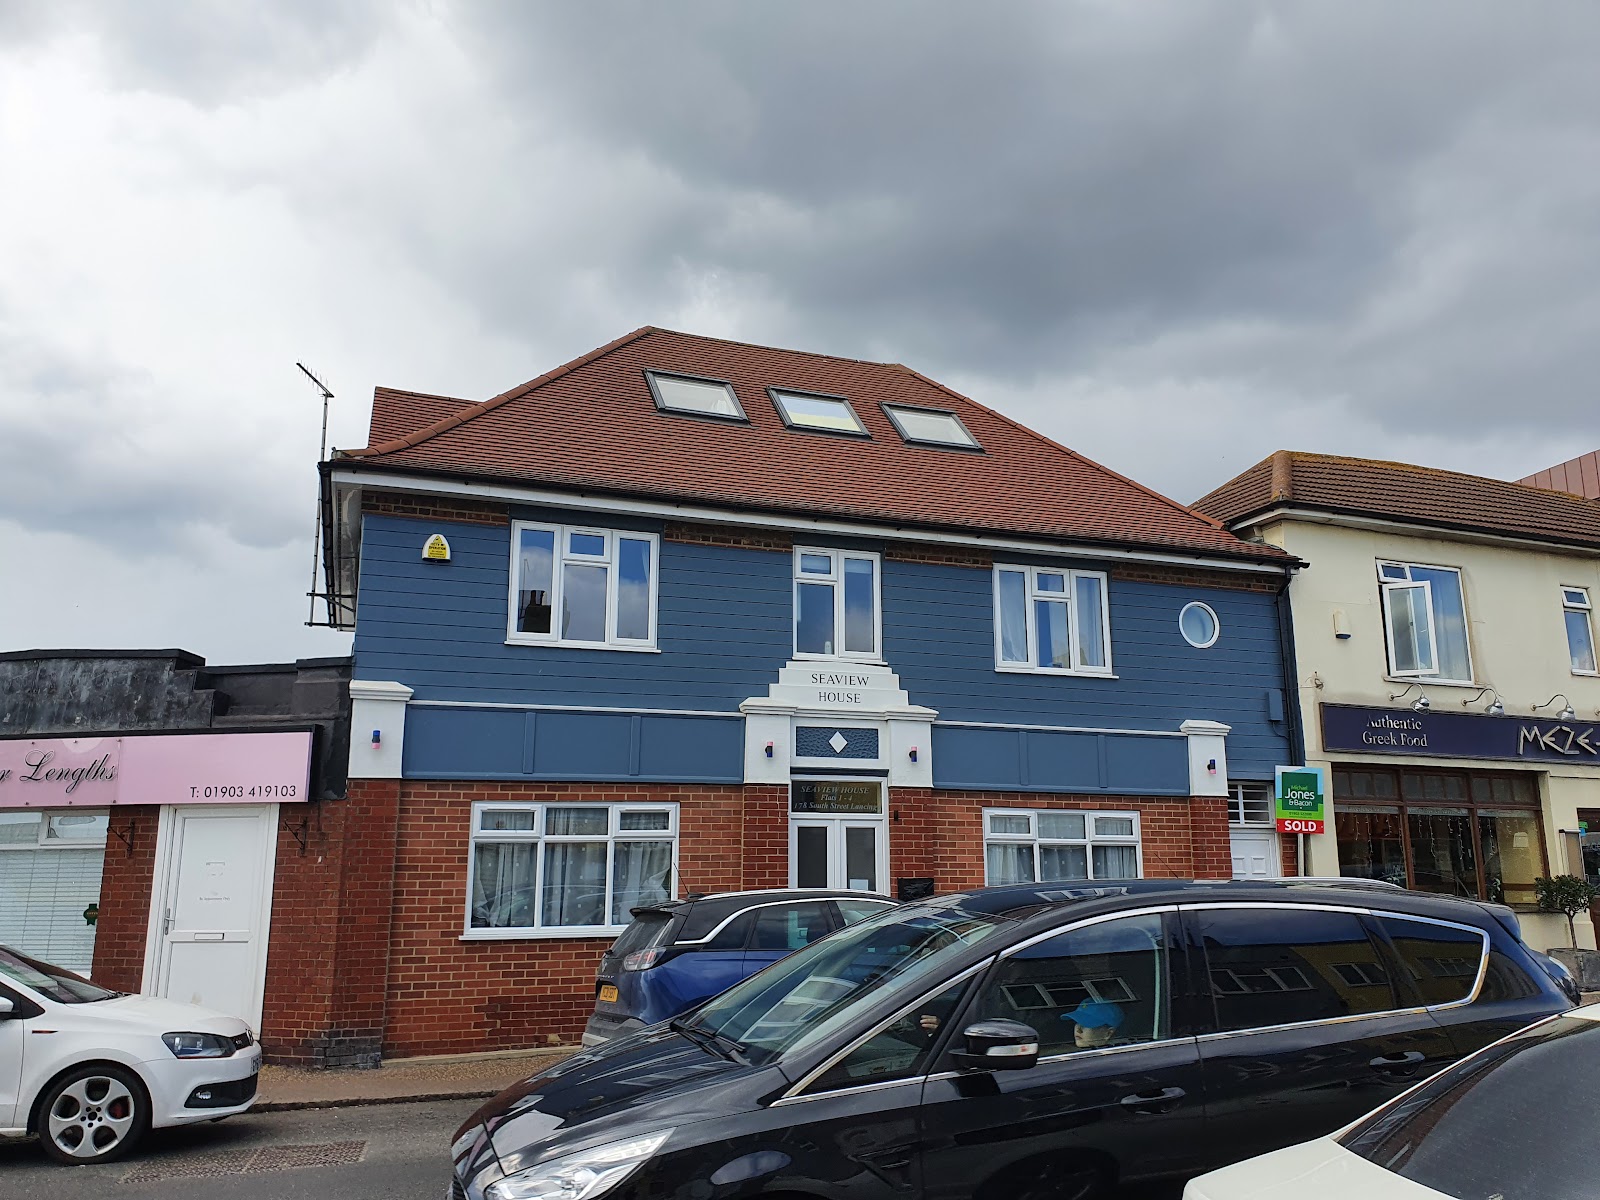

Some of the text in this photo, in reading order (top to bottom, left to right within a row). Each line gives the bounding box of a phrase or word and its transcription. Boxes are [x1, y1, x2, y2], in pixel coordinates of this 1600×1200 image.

[811, 673, 869, 686] SEAVIEW
[818, 691, 861, 703] HOUSE
[1366, 714, 1422, 730] Authentic
[1362, 730, 1428, 747] Greek Food
[19, 749, 116, 794] Lengths
[189, 785, 296, 798] T: 01903 419103
[800, 785, 838, 794] SEAVIEW
[1284, 788, 1315, 800] Jones
[808, 802, 829, 810] South
[850, 803, 878, 812] Lancing
[1284, 820, 1317, 832] SOLD
